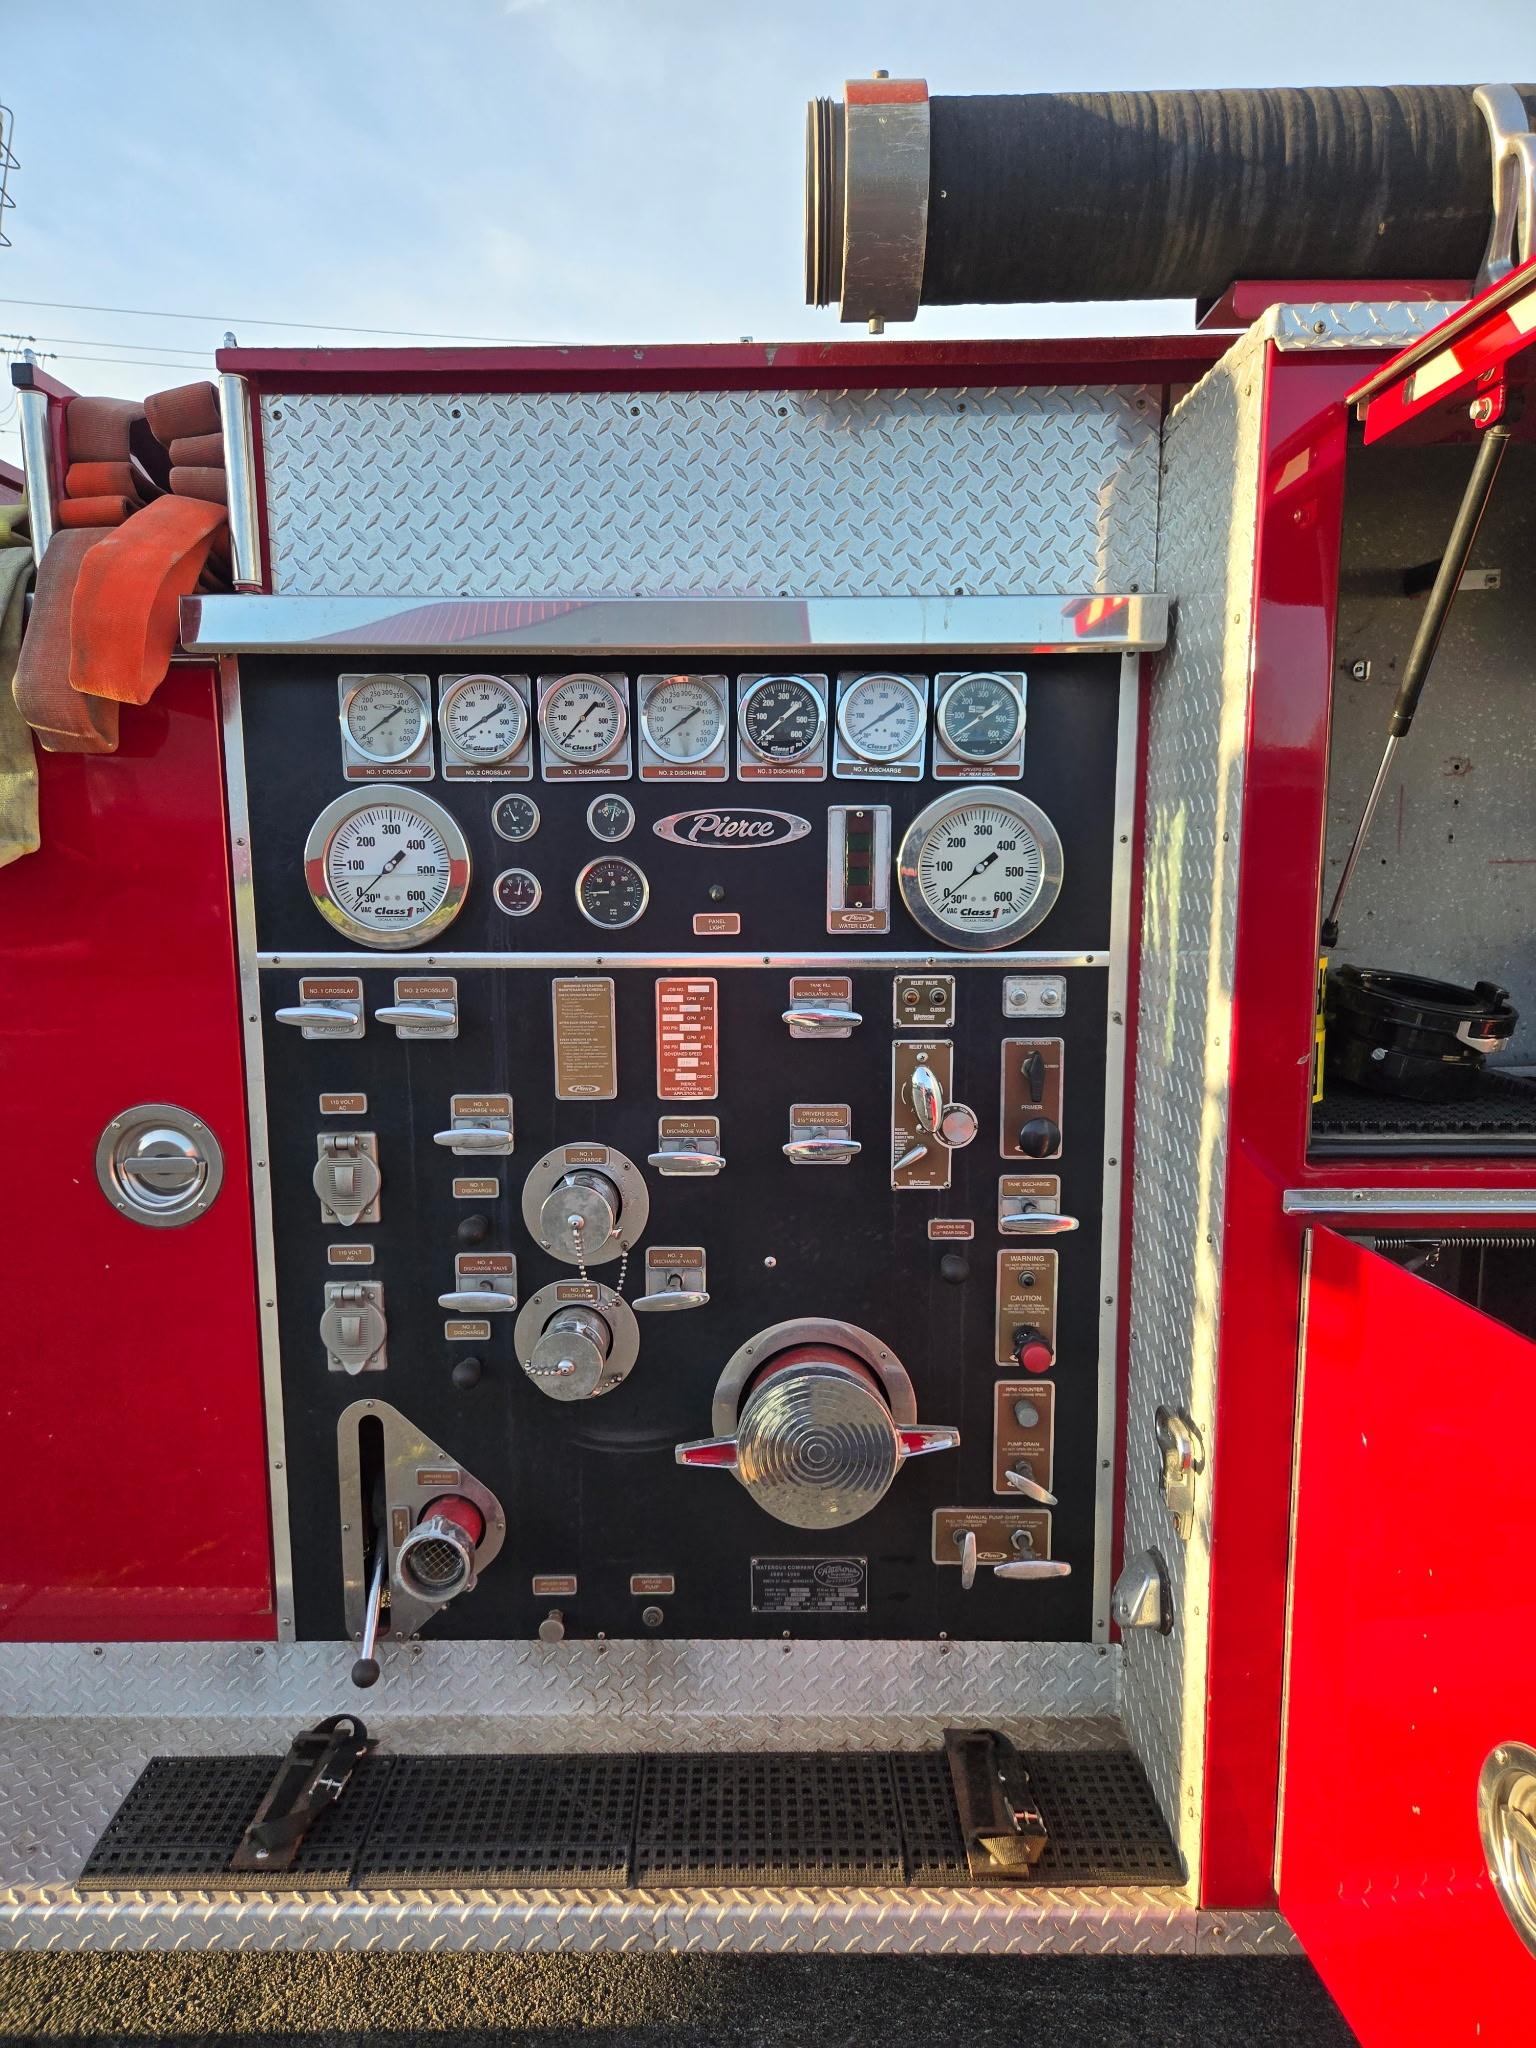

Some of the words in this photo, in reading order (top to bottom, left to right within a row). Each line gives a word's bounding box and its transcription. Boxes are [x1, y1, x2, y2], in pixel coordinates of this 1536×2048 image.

[382, 825, 400, 835] 300
[688, 814, 775, 841] Pierce
[974, 825, 992, 835] 300
[356, 837, 375, 847] 200
[406, 840, 425, 850] 400
[947, 837, 966, 848] 200
[997, 841, 1016, 851] 400
[347, 860, 364, 870] 100
[936, 861, 953, 871] 100
[417, 866, 435, 876] 500
[1005, 867, 1023, 877] 500
[356, 887, 362, 897] 0
[407, 890, 425, 900] 600
[944, 888, 950, 898] 0
[994, 892, 1012, 901] 600
